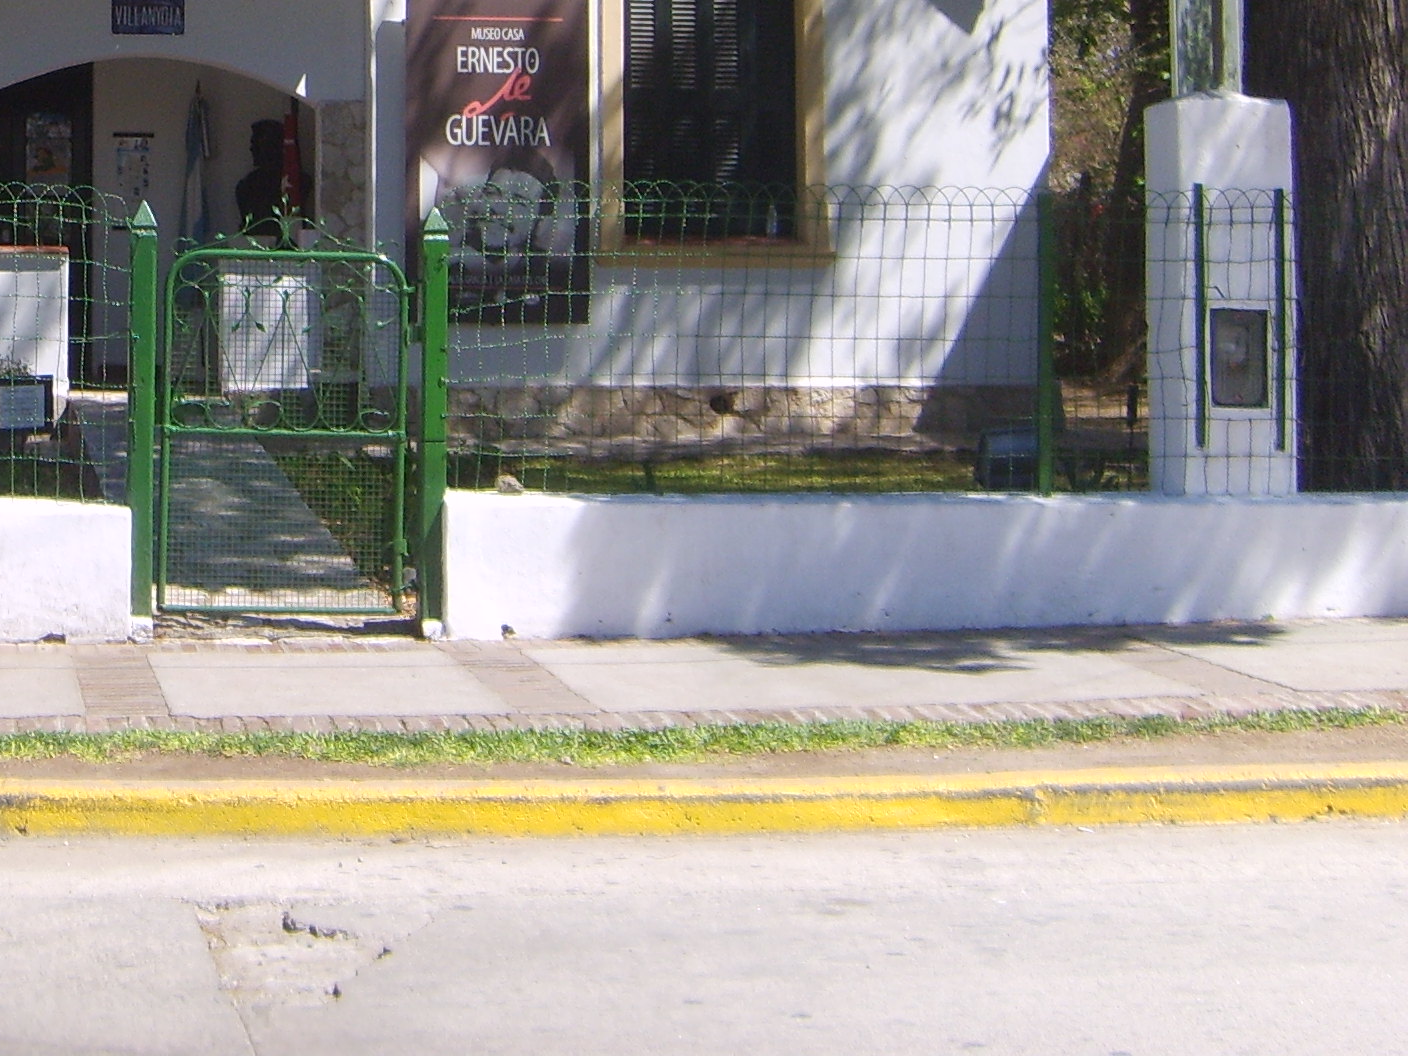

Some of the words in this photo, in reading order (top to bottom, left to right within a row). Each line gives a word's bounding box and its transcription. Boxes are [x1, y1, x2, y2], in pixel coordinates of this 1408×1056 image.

[472, 27, 500, 40] MUSEO
[502, 27, 525, 41] CASA
[457, 46, 540, 74] ERNESTO
[446, 114, 551, 147] GUEVARA
